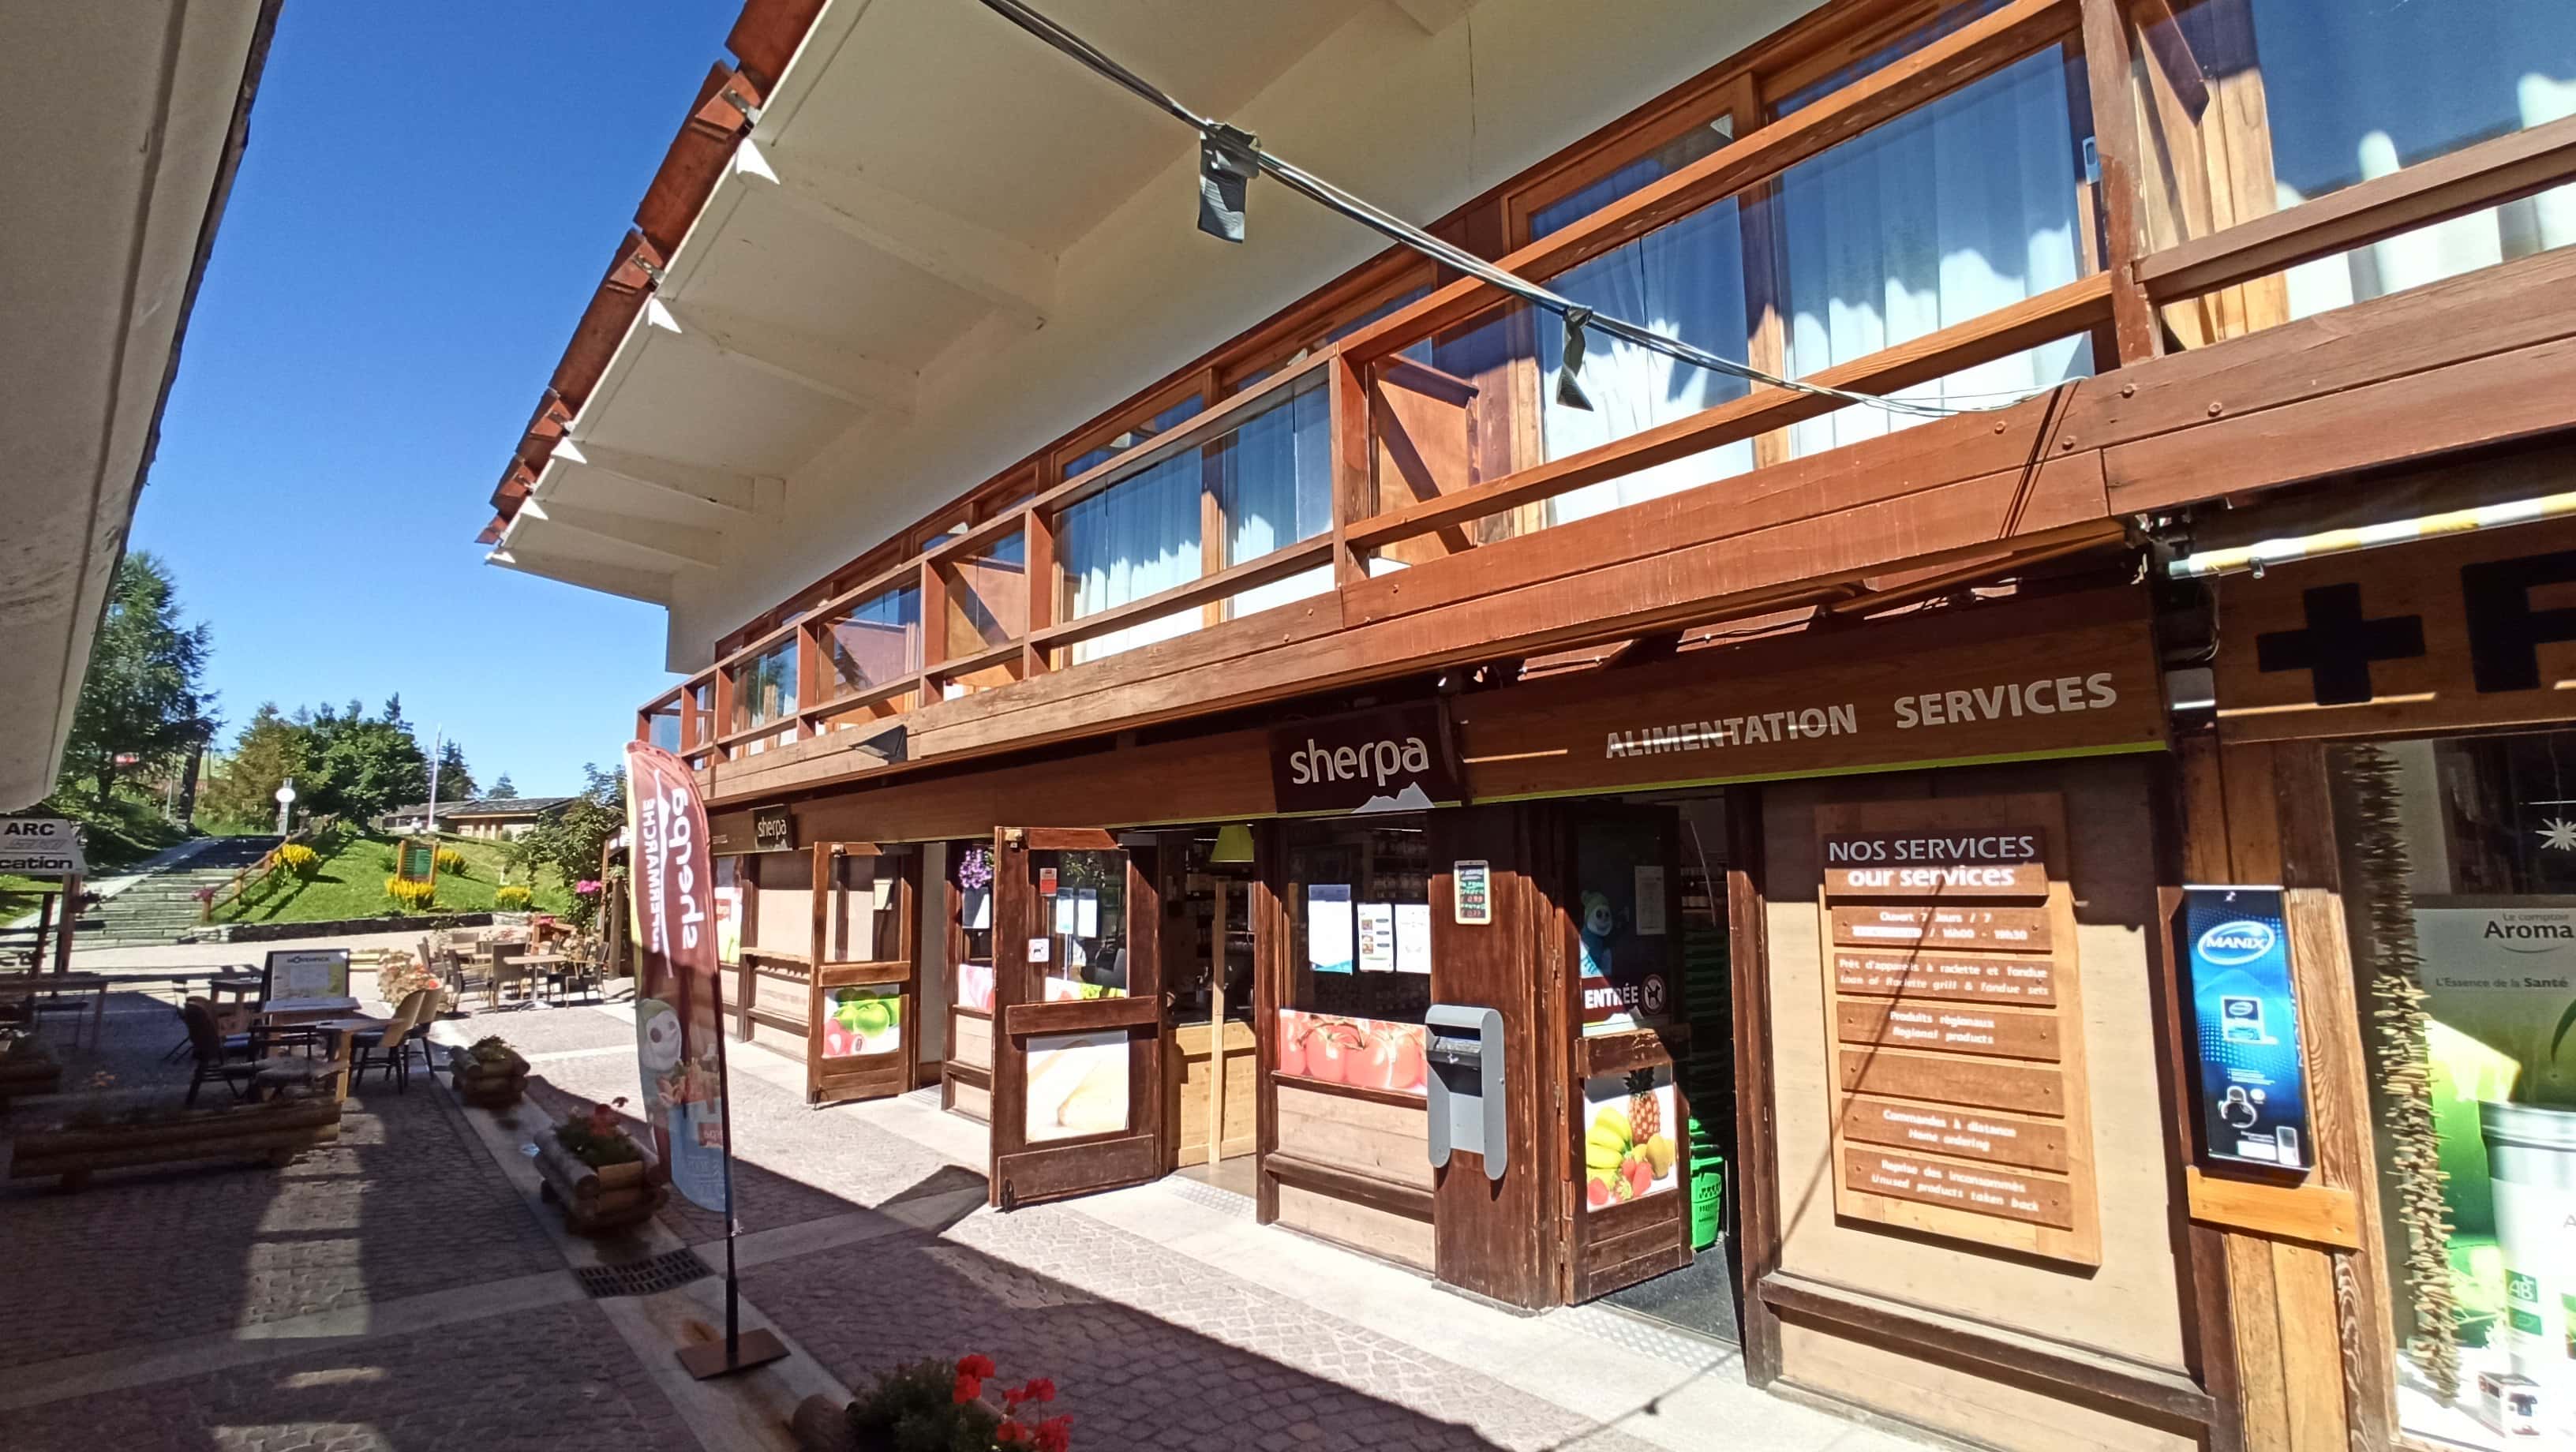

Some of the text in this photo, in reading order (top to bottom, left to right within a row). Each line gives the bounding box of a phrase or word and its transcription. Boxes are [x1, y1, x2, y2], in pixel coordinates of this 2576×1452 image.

[1607, 673, 2117, 758] ALIMENTATION SERVICES
[1290, 737, 1430, 786] sherpa
[4, 822, 55, 836] ARC
[758, 816, 787, 840] sherpa
[1829, 836, 2035, 862] NOS SERVICES
[0, 855, 73, 869] cation
[1848, 865, 2015, 887] our services
[2484, 920, 2575, 939] Aroma
[2206, 935, 2267, 949] MANIX
[1865, 960, 1920, 972] d'apparels
[1986, 967, 1999, 976] et
[2007, 965, 2048, 978] fondue
[1932, 980, 1957, 991] grill
[1980, 982, 2020, 994] fondue
[2436, 975, 2570, 988] L'Essence de la Santé
[1584, 982, 1639, 1009] ENTRÉE
[1945, 1031, 1994, 1044] products
[1916, 1181, 1964, 1198] products
